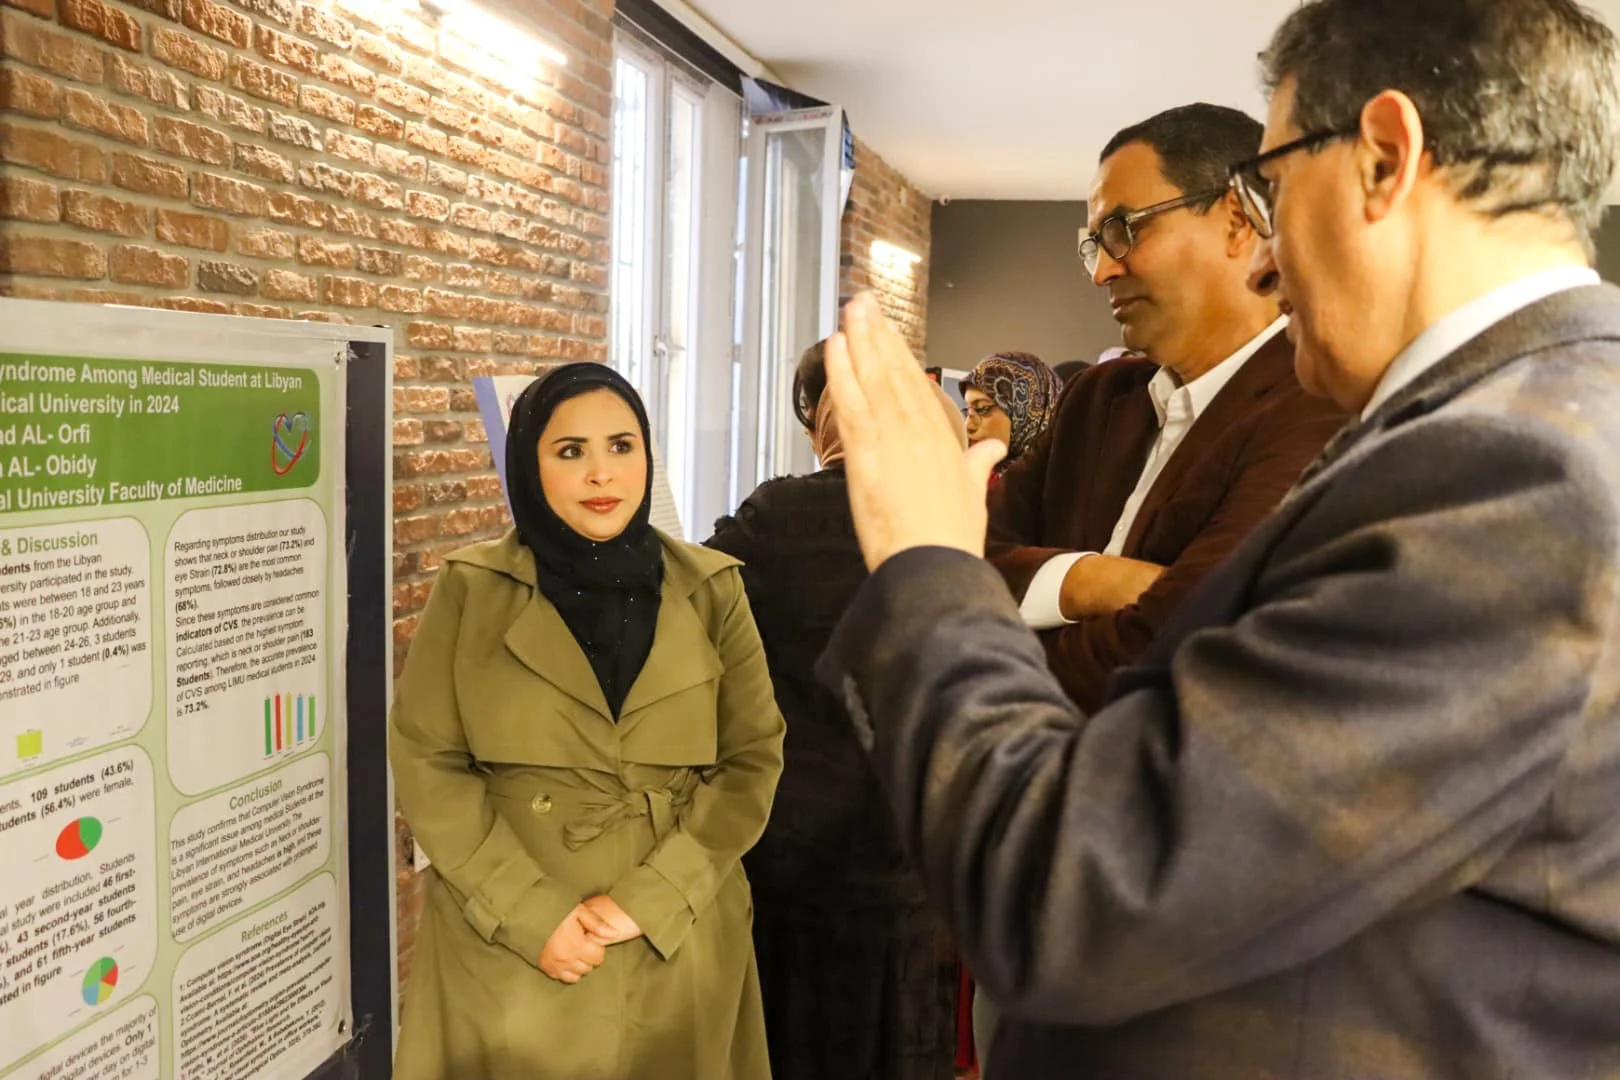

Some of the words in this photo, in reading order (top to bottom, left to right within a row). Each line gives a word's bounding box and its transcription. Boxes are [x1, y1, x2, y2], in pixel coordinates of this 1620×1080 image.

[80, 363, 137, 388] Among
[142, 366, 194, 386] Medical
[198, 369, 247, 388] Student
[250, 374, 261, 388] at
[265, 372, 302, 392] Libyan
[0, 392, 34, 413] ical
[40, 392, 126, 417] University
[129, 395, 142, 412] in
[147, 396, 179, 413] 2024
[21, 424, 54, 445] AL-
[58, 424, 90, 444] Orfi
[8, 456, 41, 477] AL-
[46, 454, 97, 477] Obidy
[18, 484, 105, 509] University
[110, 481, 164, 502] Faculty
[168, 482, 183, 497] of
[185, 476, 242, 495] Medicine
[1, 538, 12, 556] &
[18, 532, 98, 554] Discussion
[174, 538, 211, 553] Regarding
[212, 533, 244, 548] symptoms
[246, 529, 278, 543] distribution
[279, 528, 290, 537] our
[290, 526, 306, 537] study
[174, 555, 198, 567] shows
[199, 553, 212, 566] that
[213, 550, 229, 561] neck
[230, 550, 237, 559] or
[238, 544, 265, 558] shoulder
[267, 543, 278, 555] pain
[279, 538, 303, 552] (73.2%)
[304, 536, 315, 547] and
[0, 562, 31, 576] dents
[34, 560, 55, 572] from
[57, 557, 71, 569] the
[73, 553, 103, 568] Libyan
[30, 572, 82, 590] participated
[84, 573, 93, 581] in
[95, 569, 108, 579] the
[174, 572, 188, 584] eye
[189, 567, 210, 580] Strain
[211, 563, 237, 578] (72.8%)
[238, 562, 249, 572] are
[250, 558, 260, 570] the
[261, 556, 276, 567] most
[277, 553, 302, 564] common
[213, 576, 240, 591] followed
[241, 572, 263, 585] closely
[264, 571, 272, 582] by
[273, 566, 304, 580] headaches
[13, 597, 37, 609] were
[40, 590, 78, 605] between
[81, 587, 91, 598] 18
[93, 585, 109, 596] and
[111, 582, 122, 593] 23
[124, 579, 146, 593] years
[175, 616, 196, 628] Since
[197, 611, 215, 623] these
[217, 605, 250, 620] symptoms
[251, 602, 262, 611] are
[294, 590, 320, 602] common
[20, 616, 29, 625] in
[31, 612, 46, 623] the
[49, 606, 74, 620] 18-20
[76, 605, 93, 616] age
[95, 600, 120, 613] group
[122, 595, 137, 606] and
[0, 650, 19, 667] ged
[22, 643, 61, 660] between
[95, 633, 101, 645] 3
[102, 628, 137, 643] students
[13, 629, 41, 645] 21-23
[43, 627, 60, 640] age
[175, 627, 212, 643] indicators
[214, 622, 221, 634] of
[17, 665, 36, 679] and
[38, 661, 57, 675] only
[67, 652, 100, 667] student
[102, 646, 129, 661] (0.4%)
[131, 642, 146, 652] was
[44, 680, 53, 690] in
[54, 673, 80, 689] figure
[185, 685, 203, 700] CVS
[204, 680, 227, 697] among
[228, 674, 246, 689] LIMU
[247, 668, 270, 682] medical
[301, 653, 316, 668] 2024
[31, 788, 48, 802] 109
[54, 774, 95, 794] students
[101, 760, 134, 780] (43.6%)
[229, 779, 282, 810] Conclusion
[41, 795, 75, 819] (56.4%)
[79, 789, 100, 802] were
[171, 839, 185, 850] This
[187, 829, 205, 843] study
[207, 817, 237, 835] confirms
[15, 896, 35, 915] year
[100, 853, 135, 874] Students
[12, 911, 36, 931] study
[40, 901, 61, 917] were
[63, 881, 101, 907] included
[103, 876, 113, 888] 46
[115, 868, 136, 884] first-
[17, 930, 28, 943] 43
[35, 902, 93, 936] second-year
[98, 884, 135, 907] students
[6, 940, 48, 968] students
[94, 912, 104, 925] 56
[107, 899, 137, 918] fourth-
[241, 911, 288, 942] References
[14, 962, 33, 981] and
[37, 954, 47, 968] 61
[53, 933, 95, 960] fifth-year
[99, 914, 136, 938] students
[22, 983, 31, 994] in
[34, 966, 62, 987] figure
[65, 1042, 98, 1067] devices
[100, 1032, 114, 1046] the
[116, 1013, 147, 1037] majority
[148, 1006, 157, 1018] of
[119, 1053, 130, 1065] on
[132, 1036, 156, 1057] digital
[125, 1030, 145, 1046] Only
[136, 1055, 149, 1069] 1-3
